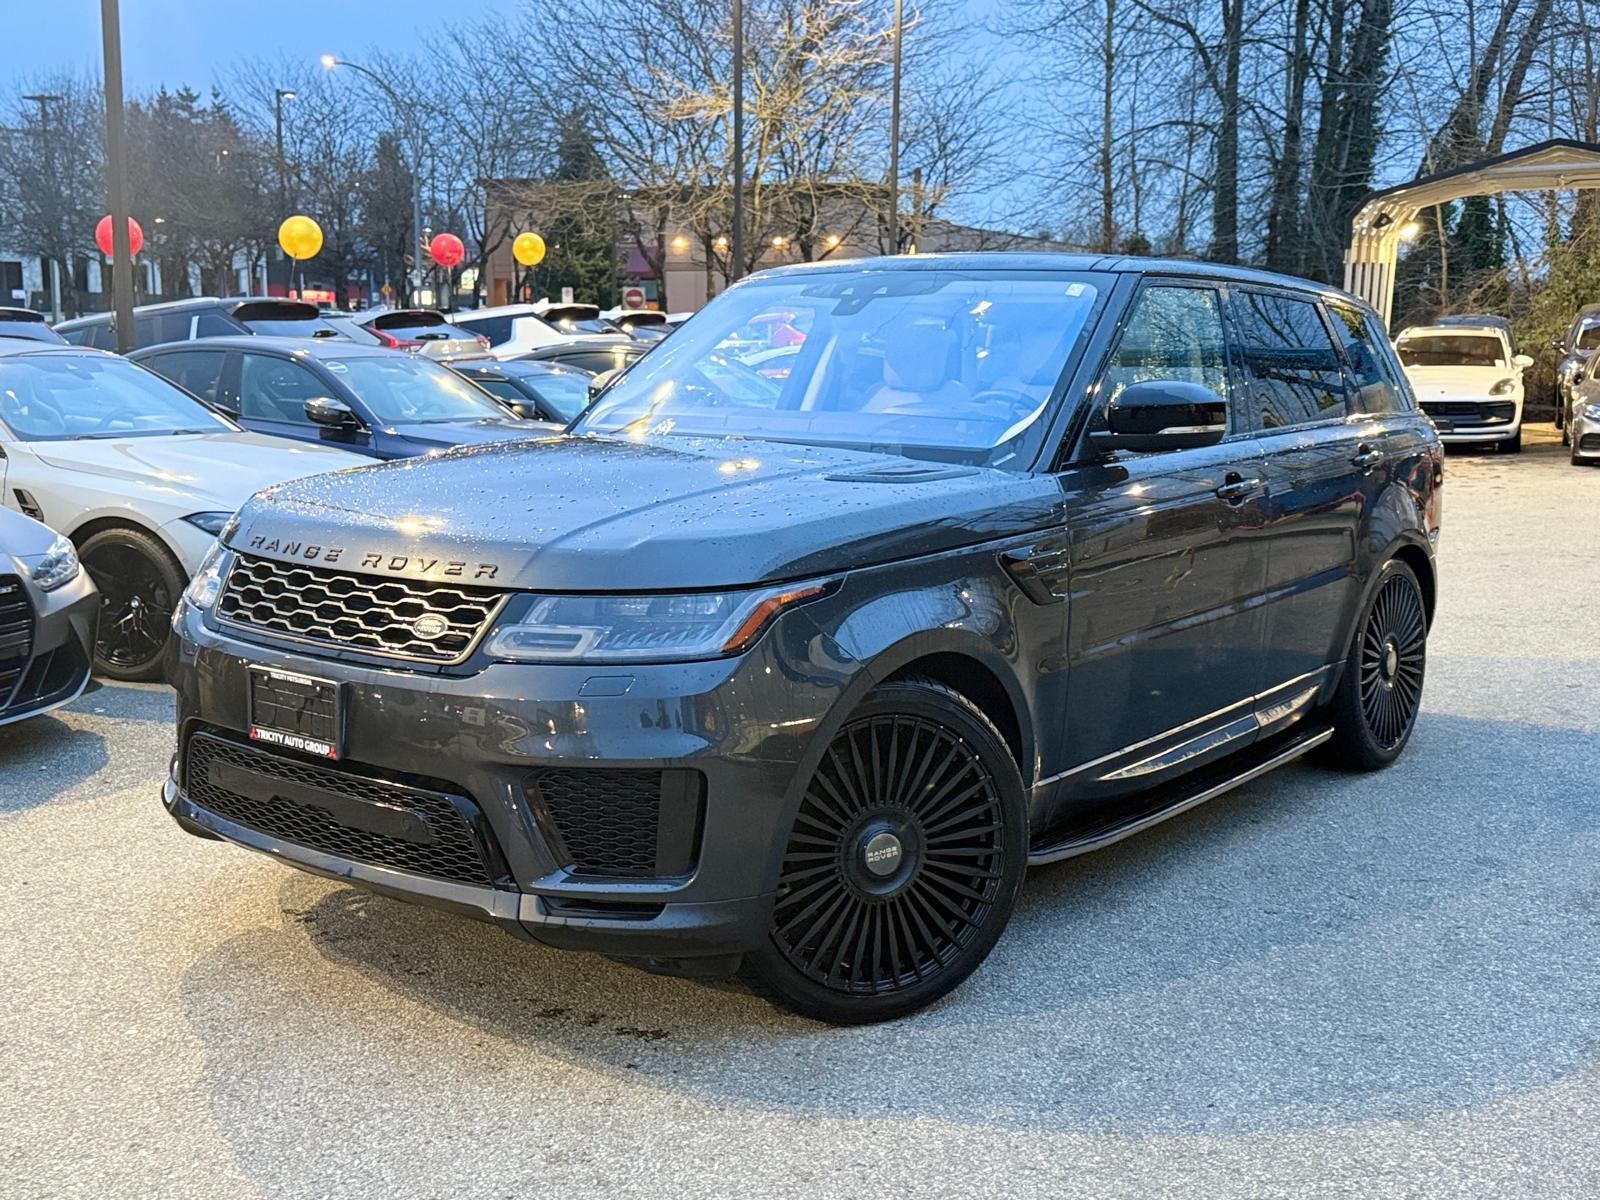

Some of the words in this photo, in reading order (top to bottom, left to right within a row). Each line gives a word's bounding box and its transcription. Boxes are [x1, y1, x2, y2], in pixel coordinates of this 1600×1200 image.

[250, 536, 343, 562] RANGE
[361, 552, 499, 579] ROVER
[256, 729, 284, 743] TRICITY
[284, 735, 303, 748] AUTO
[304, 740, 330, 755] GROUP
[867, 846, 897, 857] RANGE
[868, 851, 898, 862] ROVER
